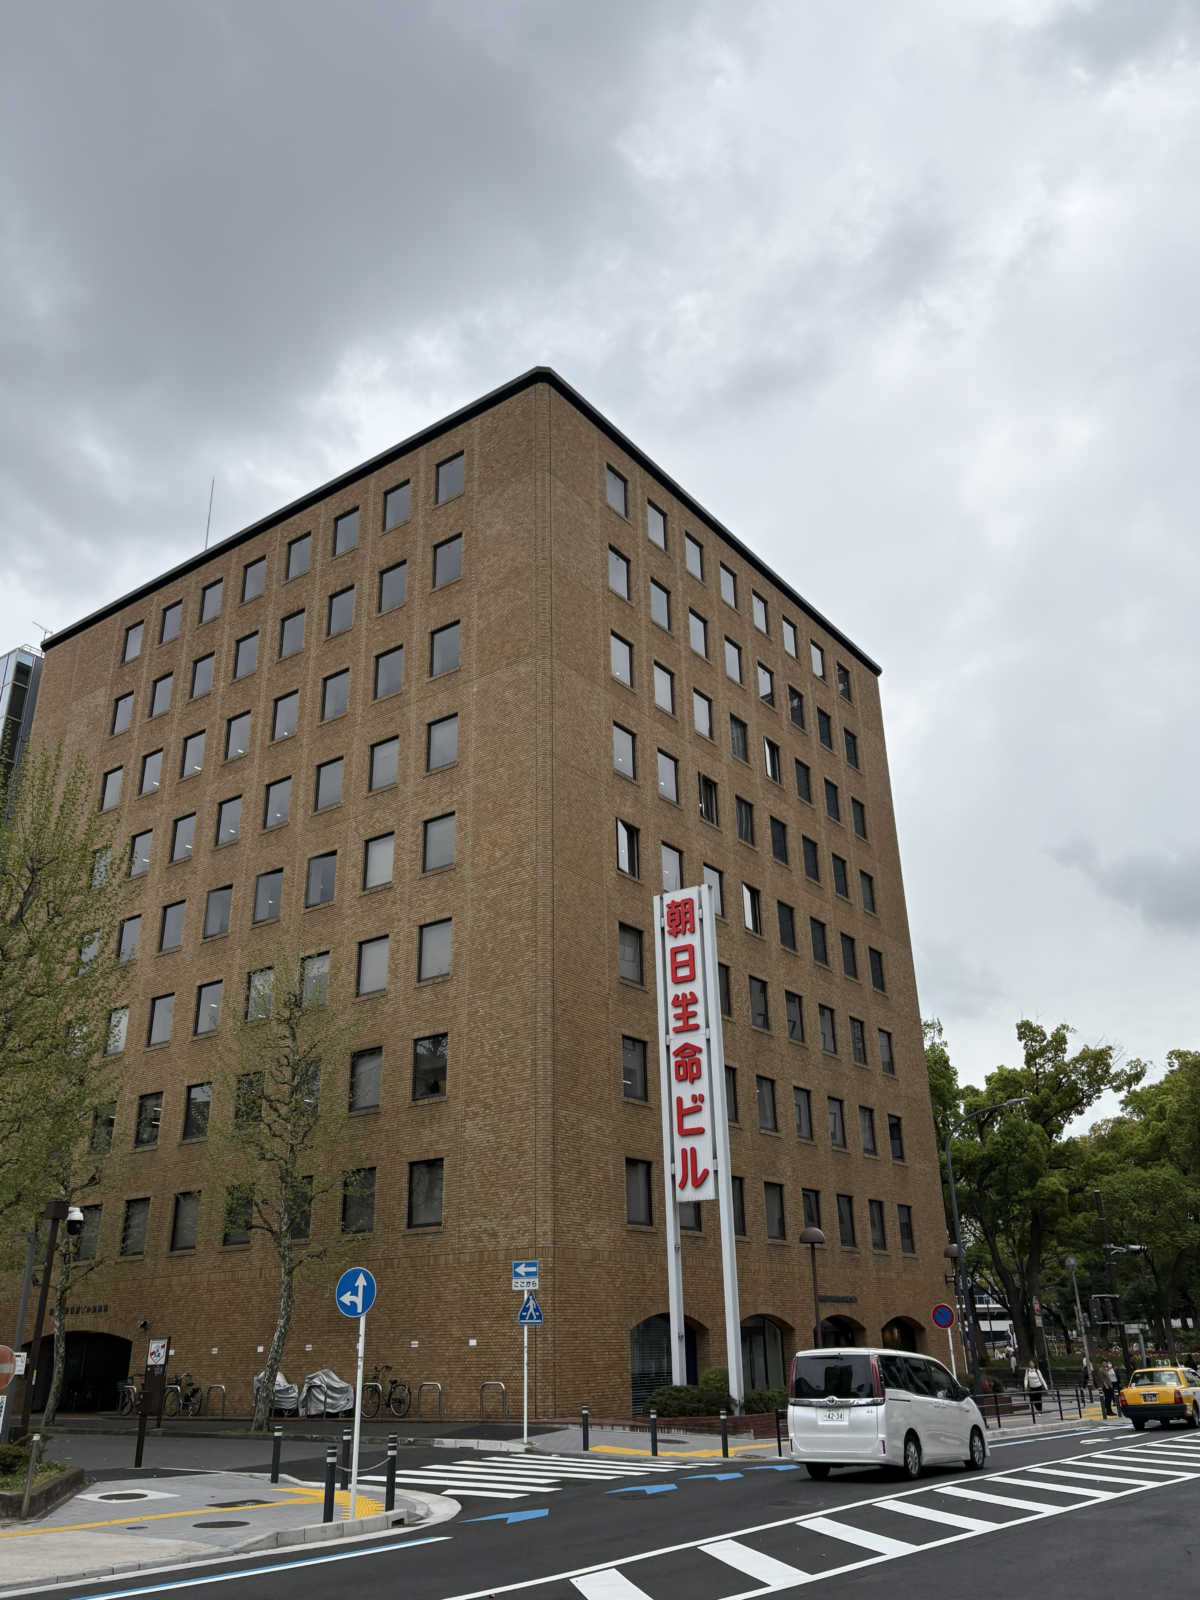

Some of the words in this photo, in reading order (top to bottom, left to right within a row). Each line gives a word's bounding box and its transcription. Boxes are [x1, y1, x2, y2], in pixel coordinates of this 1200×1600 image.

[666, 897, 709, 1189] 朝日生命ビル
